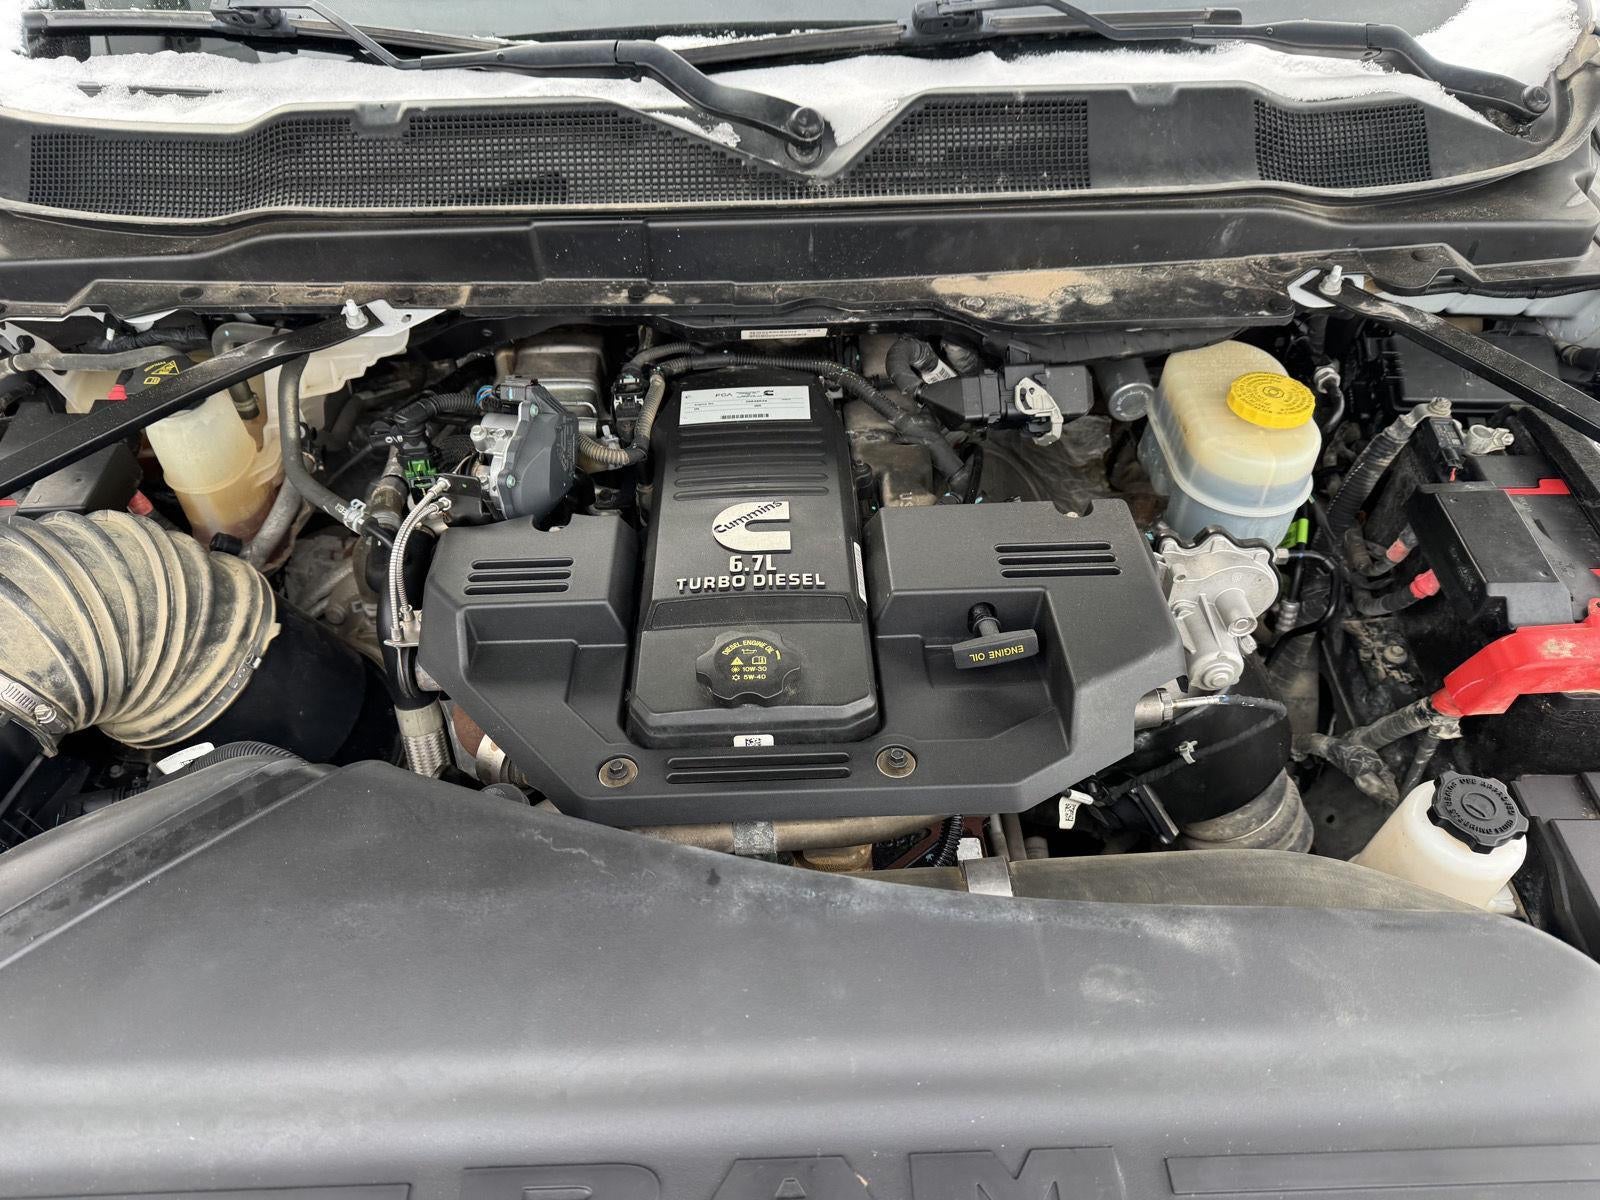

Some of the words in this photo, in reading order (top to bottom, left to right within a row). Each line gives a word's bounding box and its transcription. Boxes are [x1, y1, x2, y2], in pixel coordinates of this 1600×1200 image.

[713, 500, 783, 534] Cummins
[729, 554, 778, 574] 6.7L
[676, 575, 746, 592] TURBO
[753, 573, 826, 588] DIESEL
[722, 642, 743, 655] DIESEL
[742, 640, 768, 649] ENGINE
[988, 645, 1024, 659] ENGINE
[969, 652, 986, 662] OIL
